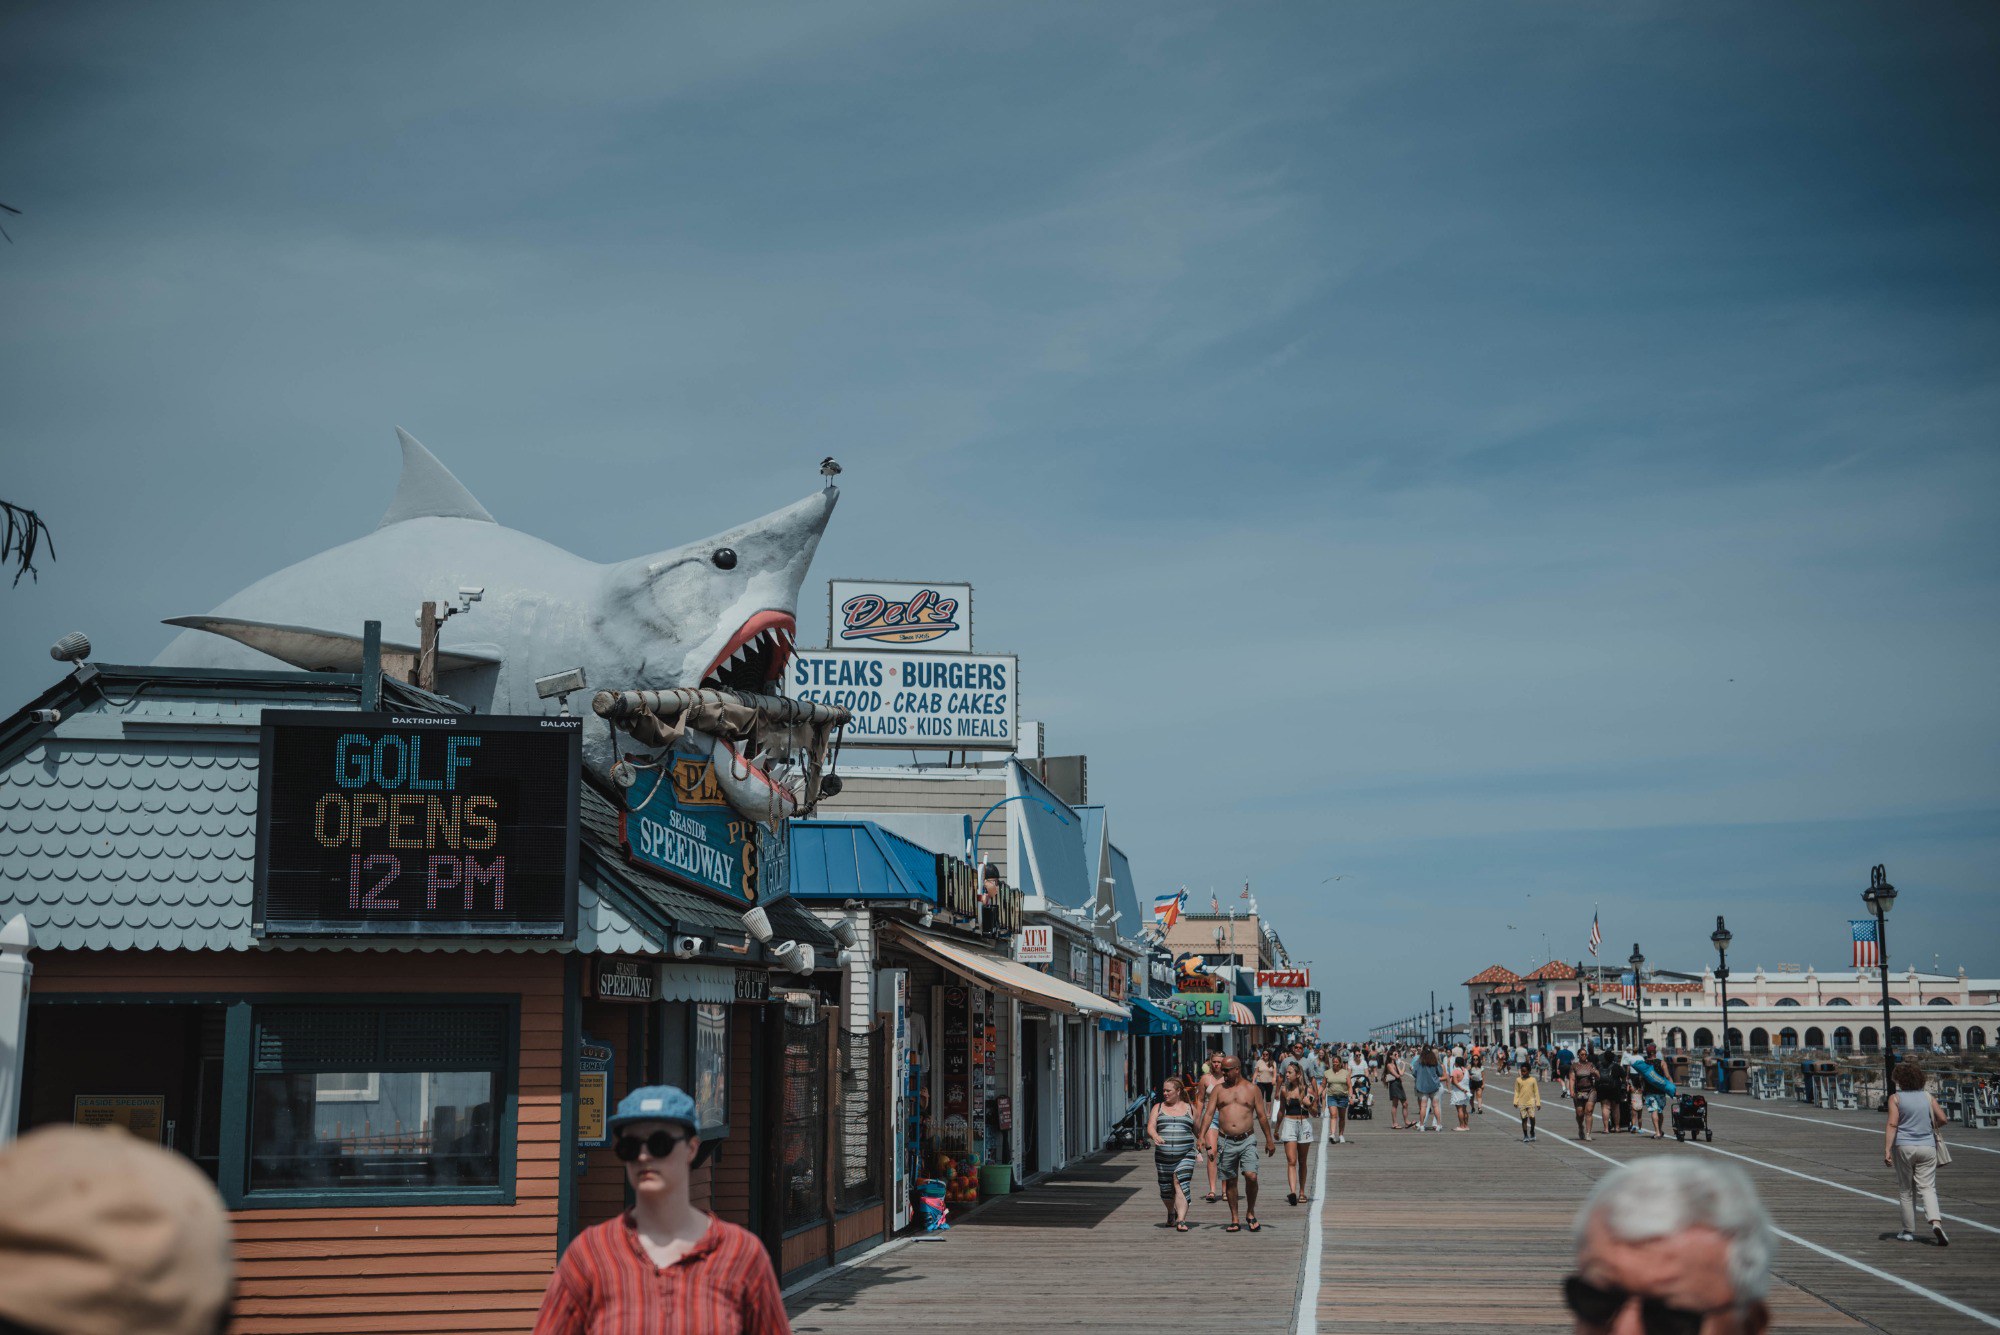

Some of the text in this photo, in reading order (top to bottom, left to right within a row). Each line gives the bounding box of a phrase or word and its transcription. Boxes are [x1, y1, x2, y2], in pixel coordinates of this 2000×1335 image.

[842, 589, 959, 628] Del's
[795, 658, 1006, 690] STEAKS BURGERS
[797, 689, 1007, 715] SEAFOOD CRAB CAKES
[392, 716, 579, 728] DAKTRONICS GALAXY
[849, 716, 907, 735] SALADS
[917, 717, 953, 736] KIDS
[957, 719, 1008, 738] MEALS
[335, 733, 481, 790] GOLF
[314, 793, 498, 849] OPENS
[669, 809, 707, 842] SEASIDE
[640, 816, 734, 889] SPEEDWAY
[349, 853, 505, 910] 12 PM
[1022, 929, 1047, 947] ATM
[616, 962, 638, 976] SEASIDE
[1257, 970, 1306, 988] PIZZA
[600, 973, 652, 998] SPEEDWAY
[737, 981, 763, 999] GOLF
[1186, 1000, 1222, 1018] GOLF
[580, 1061, 606, 1070] EDWAY
[580, 1097, 595, 1106] ICES
